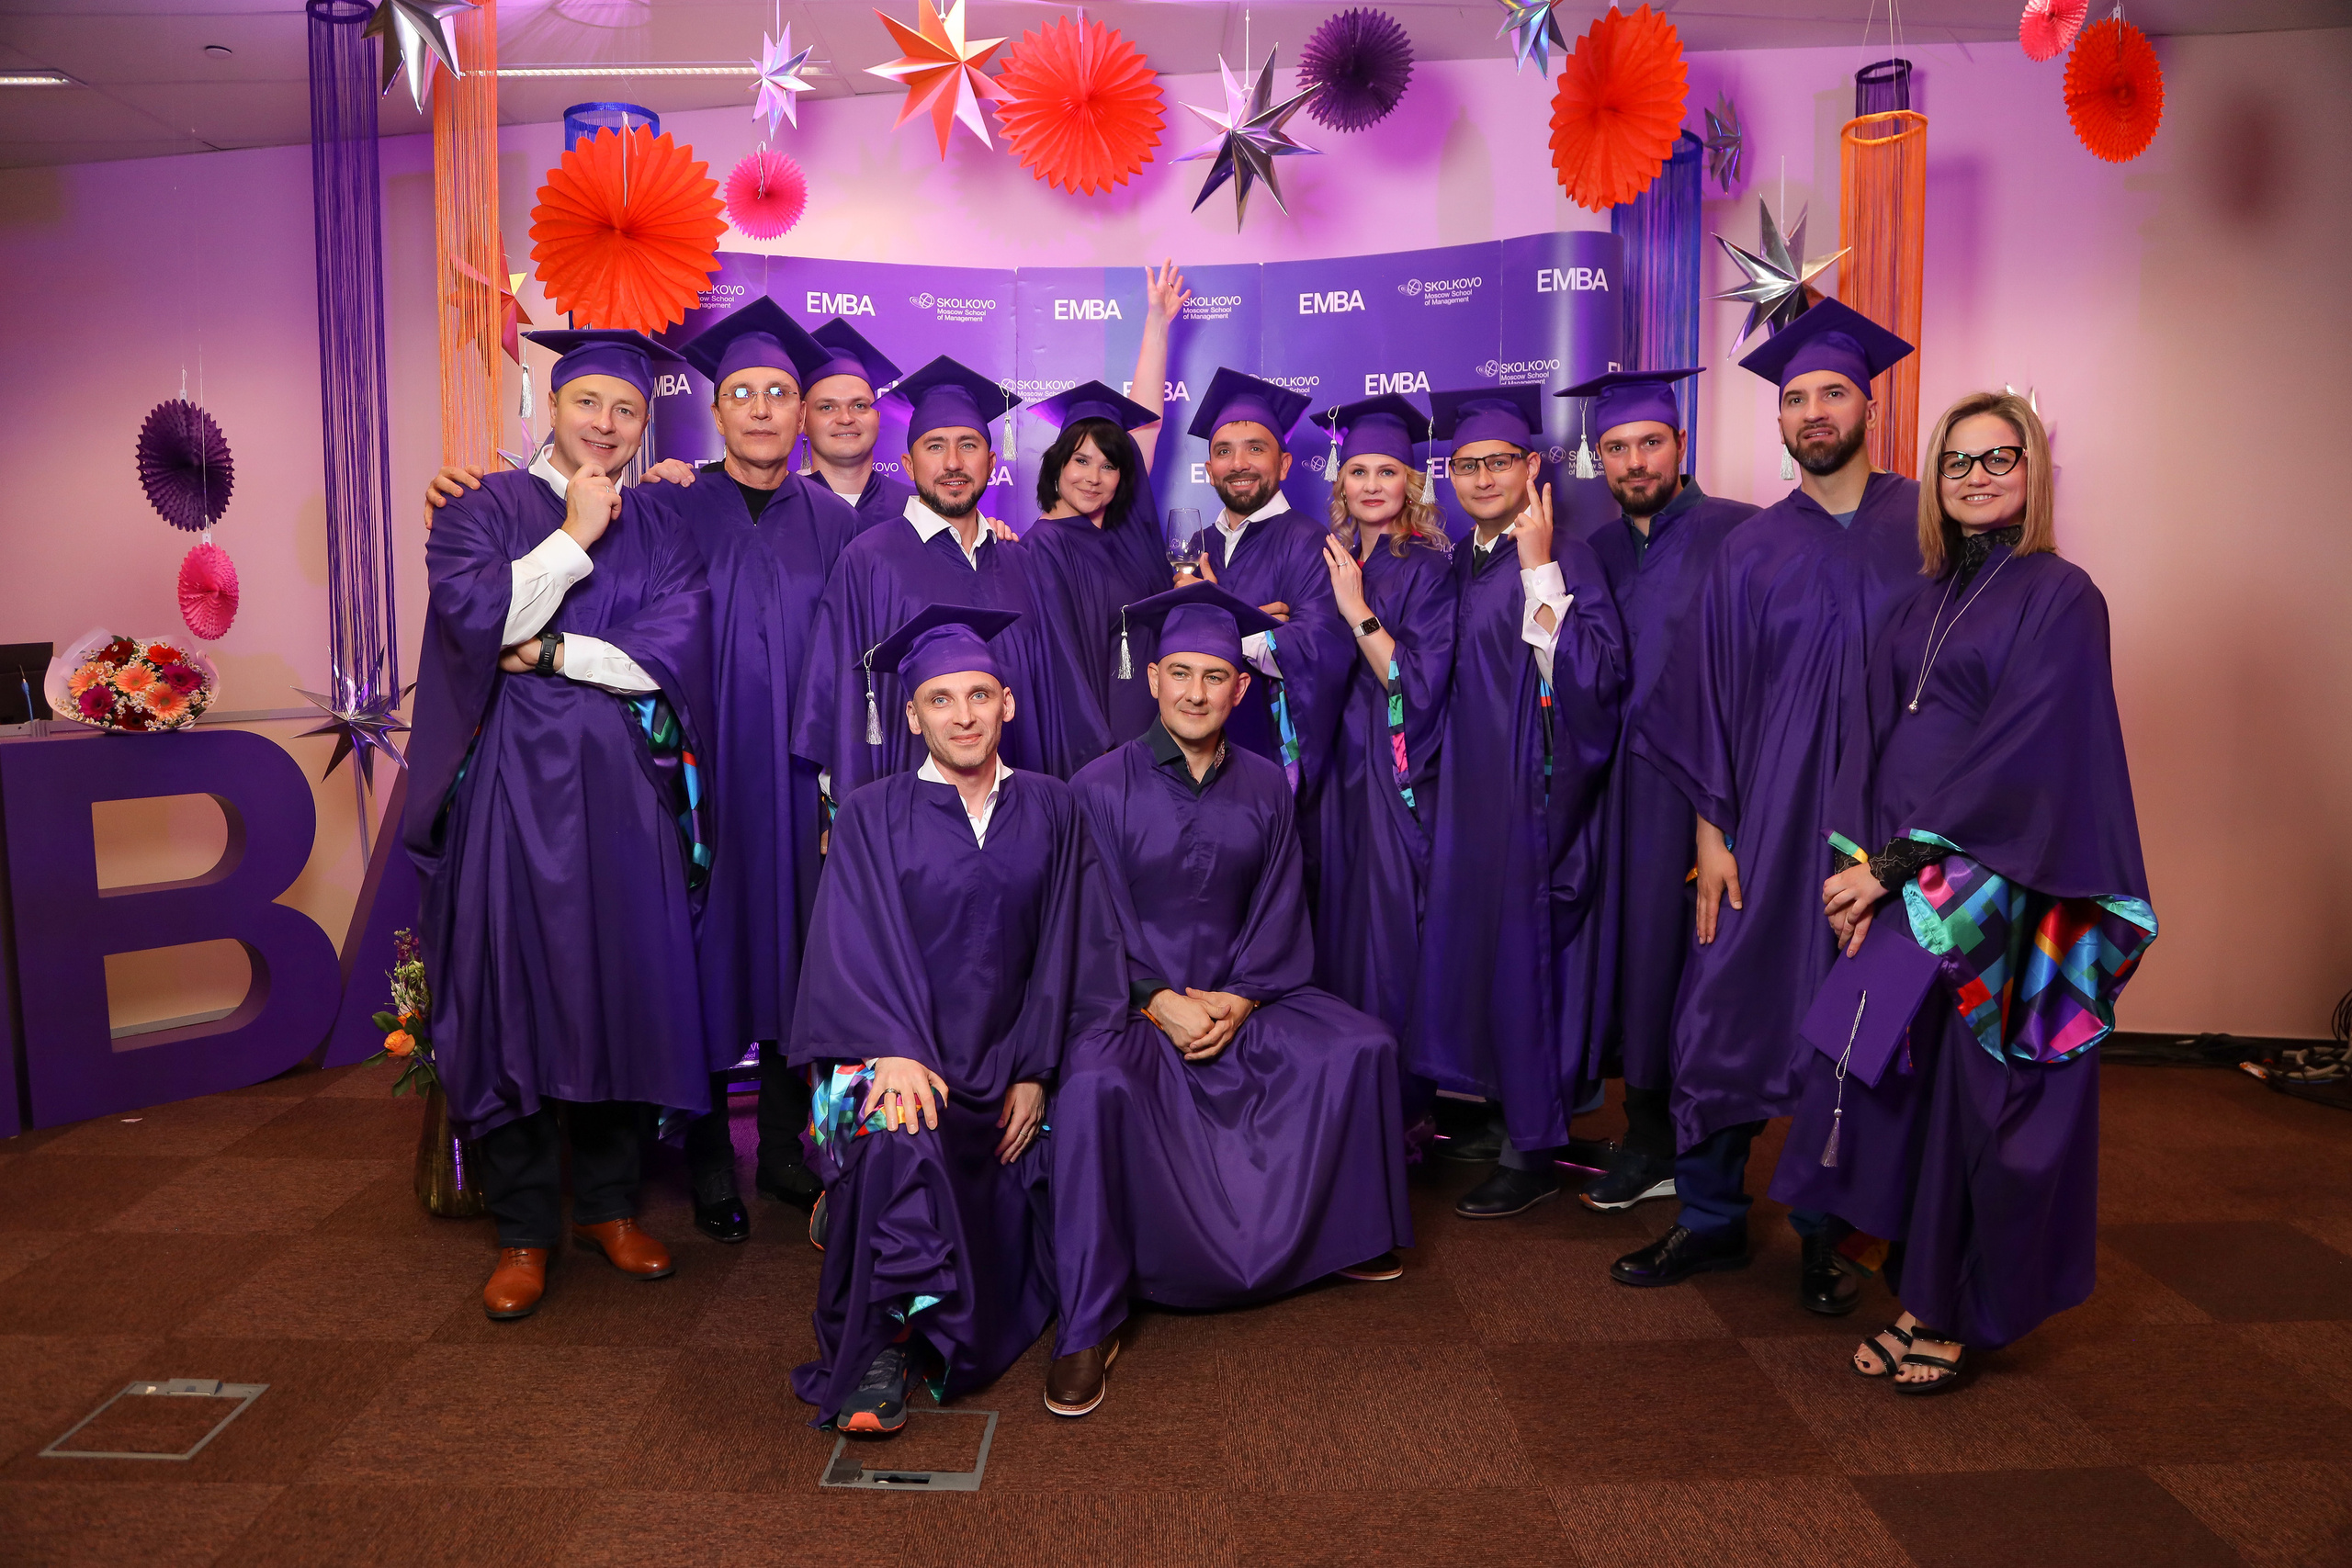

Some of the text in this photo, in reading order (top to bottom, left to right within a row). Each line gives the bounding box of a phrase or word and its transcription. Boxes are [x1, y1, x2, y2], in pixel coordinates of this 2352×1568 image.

[1424, 276, 1482, 292] SKOLKOVO
[1537, 267, 1609, 293] EMBA
[1431, 296, 1470, 305] Management
[1451, 289, 1473, 298] School
[807, 291, 876, 316] EMBA
[937, 298, 996, 310] SKOLKOVO
[1182, 296, 1242, 307] SKOLKOVO
[1299, 289, 1366, 314] EMBA
[1054, 299, 1122, 320] EMBA
[944, 314, 983, 322] Management
[1501, 359, 1560, 374] SKOLKOVO
[653, 373, 692, 399] MBA
[1017, 379, 1076, 389] SKOLKOVO
[1261, 376, 1320, 387] KOLKOVO
[1365, 371, 1431, 395] EMBA
[1123, 381, 1191, 401] EBA
